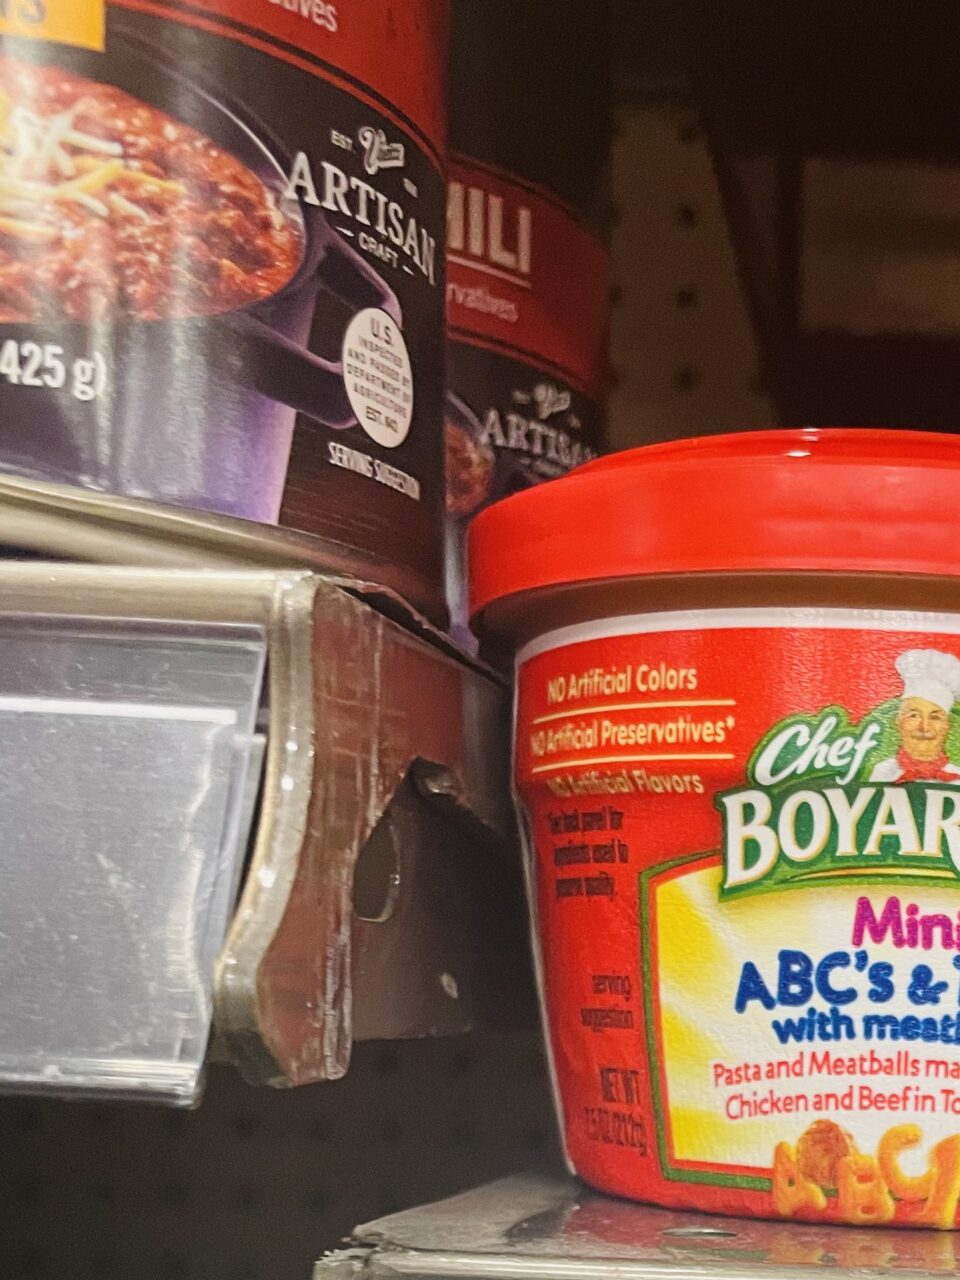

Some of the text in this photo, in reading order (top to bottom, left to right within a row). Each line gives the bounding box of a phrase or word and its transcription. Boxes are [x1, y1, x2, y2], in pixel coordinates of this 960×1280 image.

[285, 150, 436, 287] ARTISAN
[358, 231, 399, 268] CRAFT
[370, 317, 394, 346] U.S.
[0, 339, 107, 401] 425 g)
[547, 663, 697, 702] NO Artificial Colors
[756, 717, 879, 786] Chef
[569, 770, 632, 796] Artificial
[635, 769, 704, 795] Flavors
[734, 949, 895, 1015] ABC's
[907, 964, 950, 1003] &
[772, 1008, 855, 1044] with
[713, 1062, 761, 1088] Pasta
[765, 1052, 803, 1079] and
[808, 1050, 919, 1078] Meatballs
[725, 1090, 808, 1120] Chicken
[813, 1086, 854, 1114] and
[858, 1085, 910, 1111] Beef
[913, 1088, 937, 1113] in
